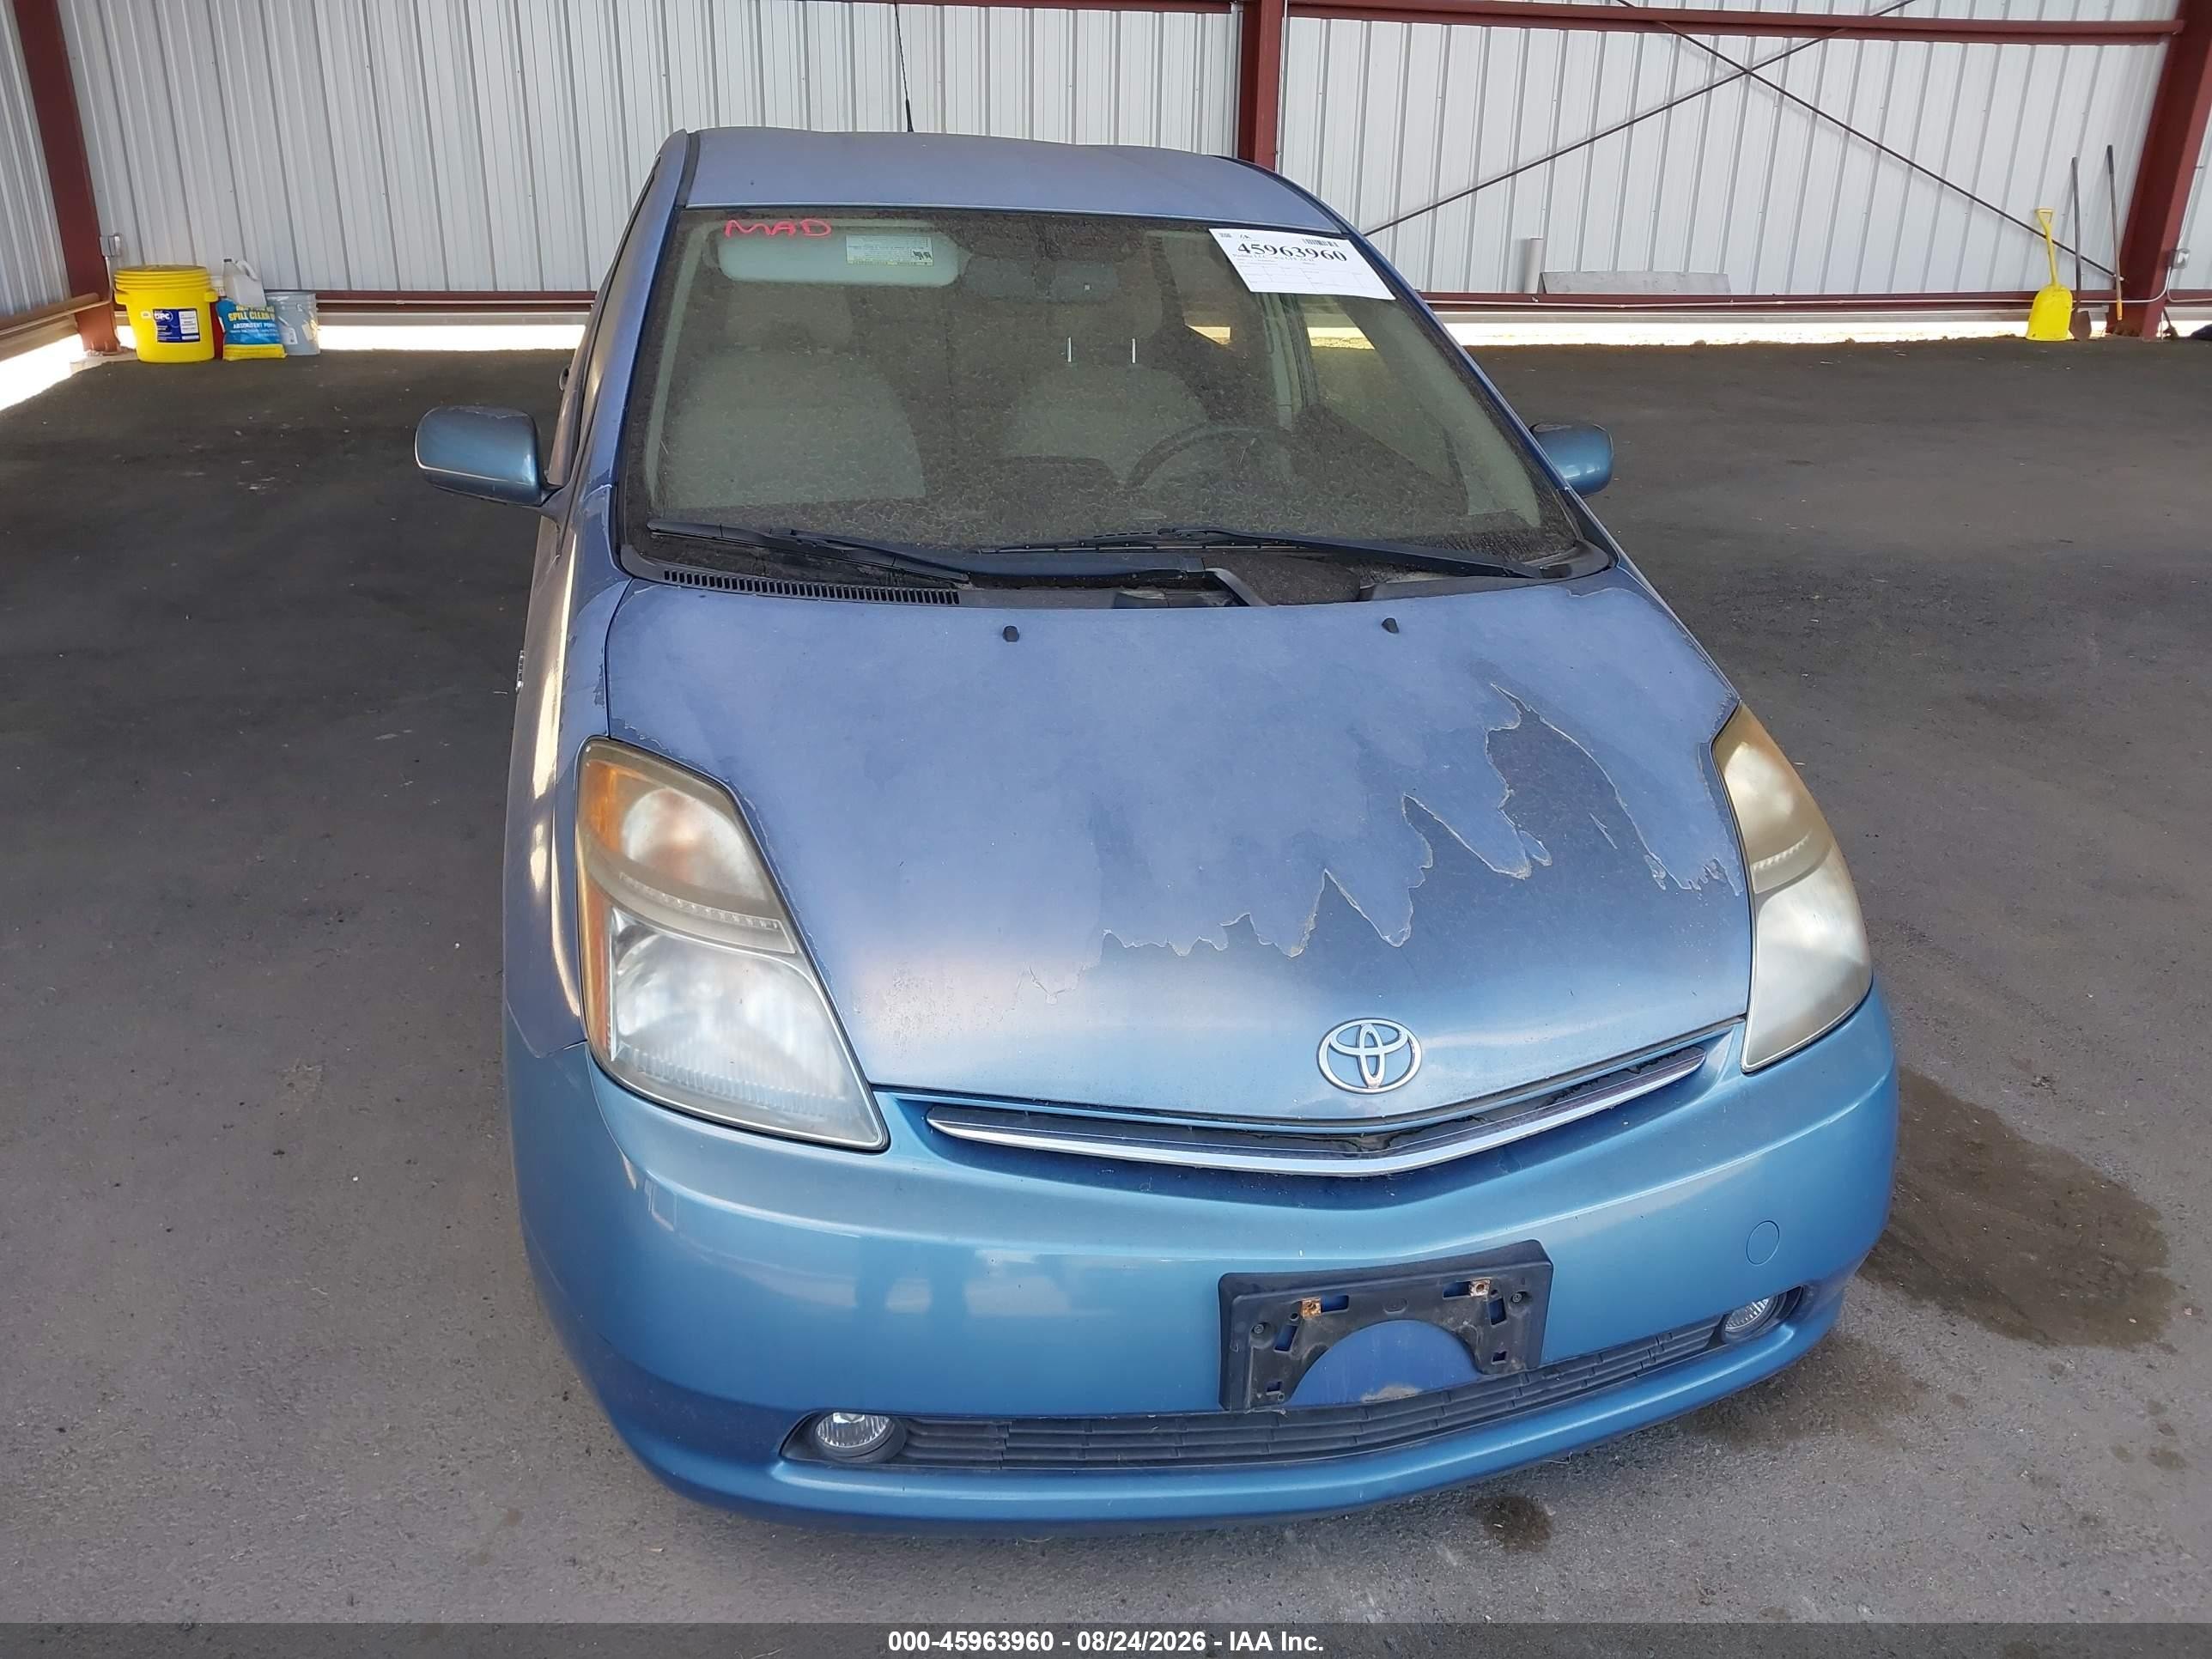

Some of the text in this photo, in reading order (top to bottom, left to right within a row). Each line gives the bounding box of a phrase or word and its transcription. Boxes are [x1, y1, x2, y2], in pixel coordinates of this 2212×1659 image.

[724, 219, 832, 238] MAD
[1237, 242, 1347, 262] 45963960
[228, 311, 248, 321] SPILL
